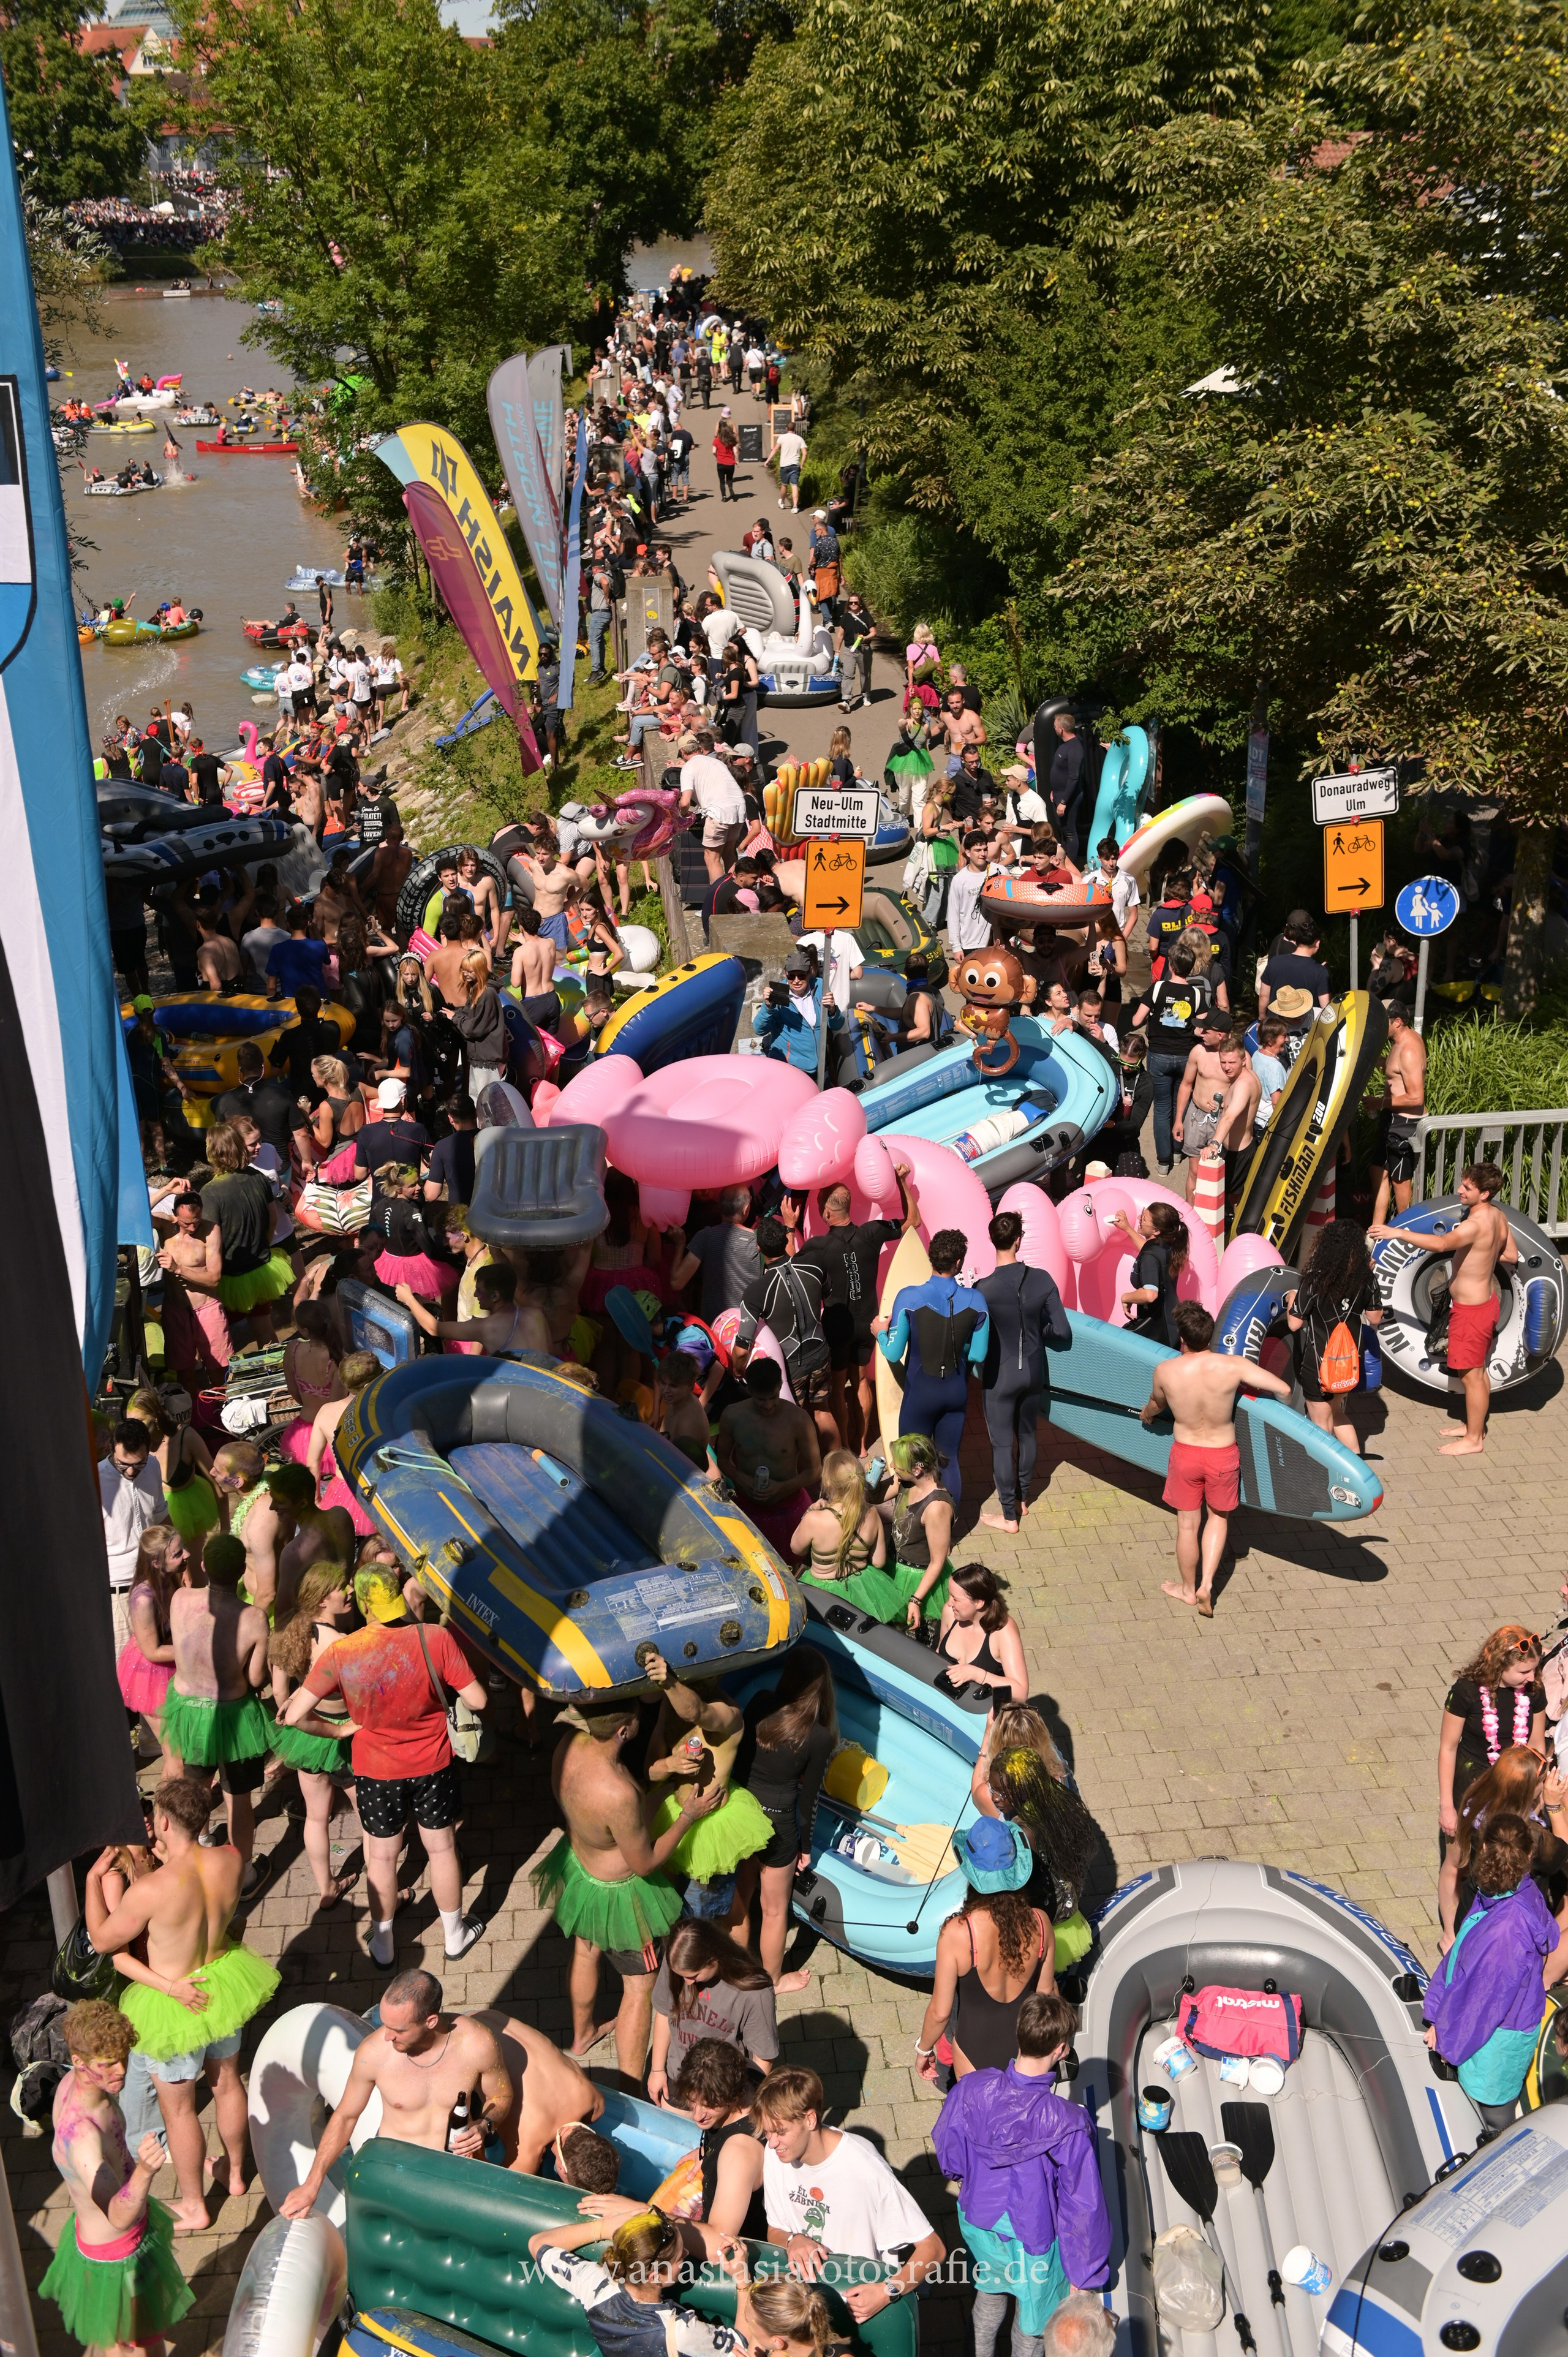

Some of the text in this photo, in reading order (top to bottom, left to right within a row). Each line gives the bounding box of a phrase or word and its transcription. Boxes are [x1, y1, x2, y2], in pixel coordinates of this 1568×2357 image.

[1320, 779, 1390, 798] Donauradweg
[812, 796, 863, 810] Neu-Ulm
[1346, 799, 1365, 811] Ulm
[805, 814, 866, 829] Stadtmitte
[1312, 1101, 1326, 1125] 200
[1331, 1378, 1357, 1390] CEDEVITA
[466, 1593, 499, 1627] INTEX
